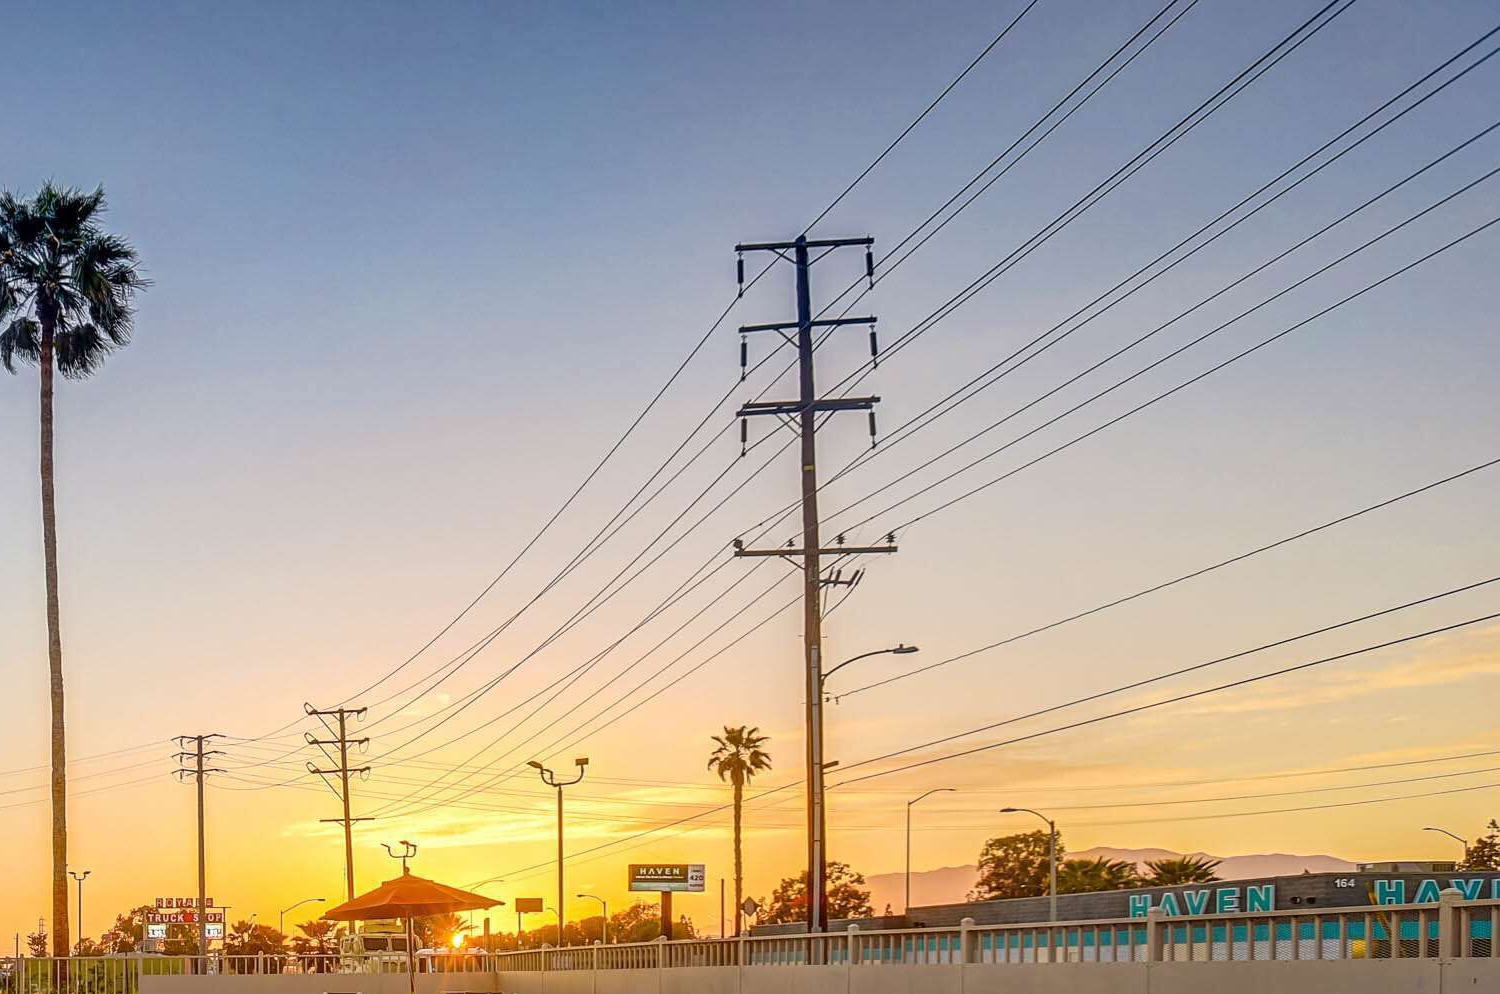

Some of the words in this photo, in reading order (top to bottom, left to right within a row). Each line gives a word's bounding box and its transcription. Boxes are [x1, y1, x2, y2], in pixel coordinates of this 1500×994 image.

[640, 867, 680, 875] HAVEN
[1334, 878, 1356, 888] 164
[1374, 878, 1500, 906] HAV
[1129, 884, 1275, 919] HAVEN
[148, 914, 184, 922] TRUCK
[193, 914, 222, 922] SOP
